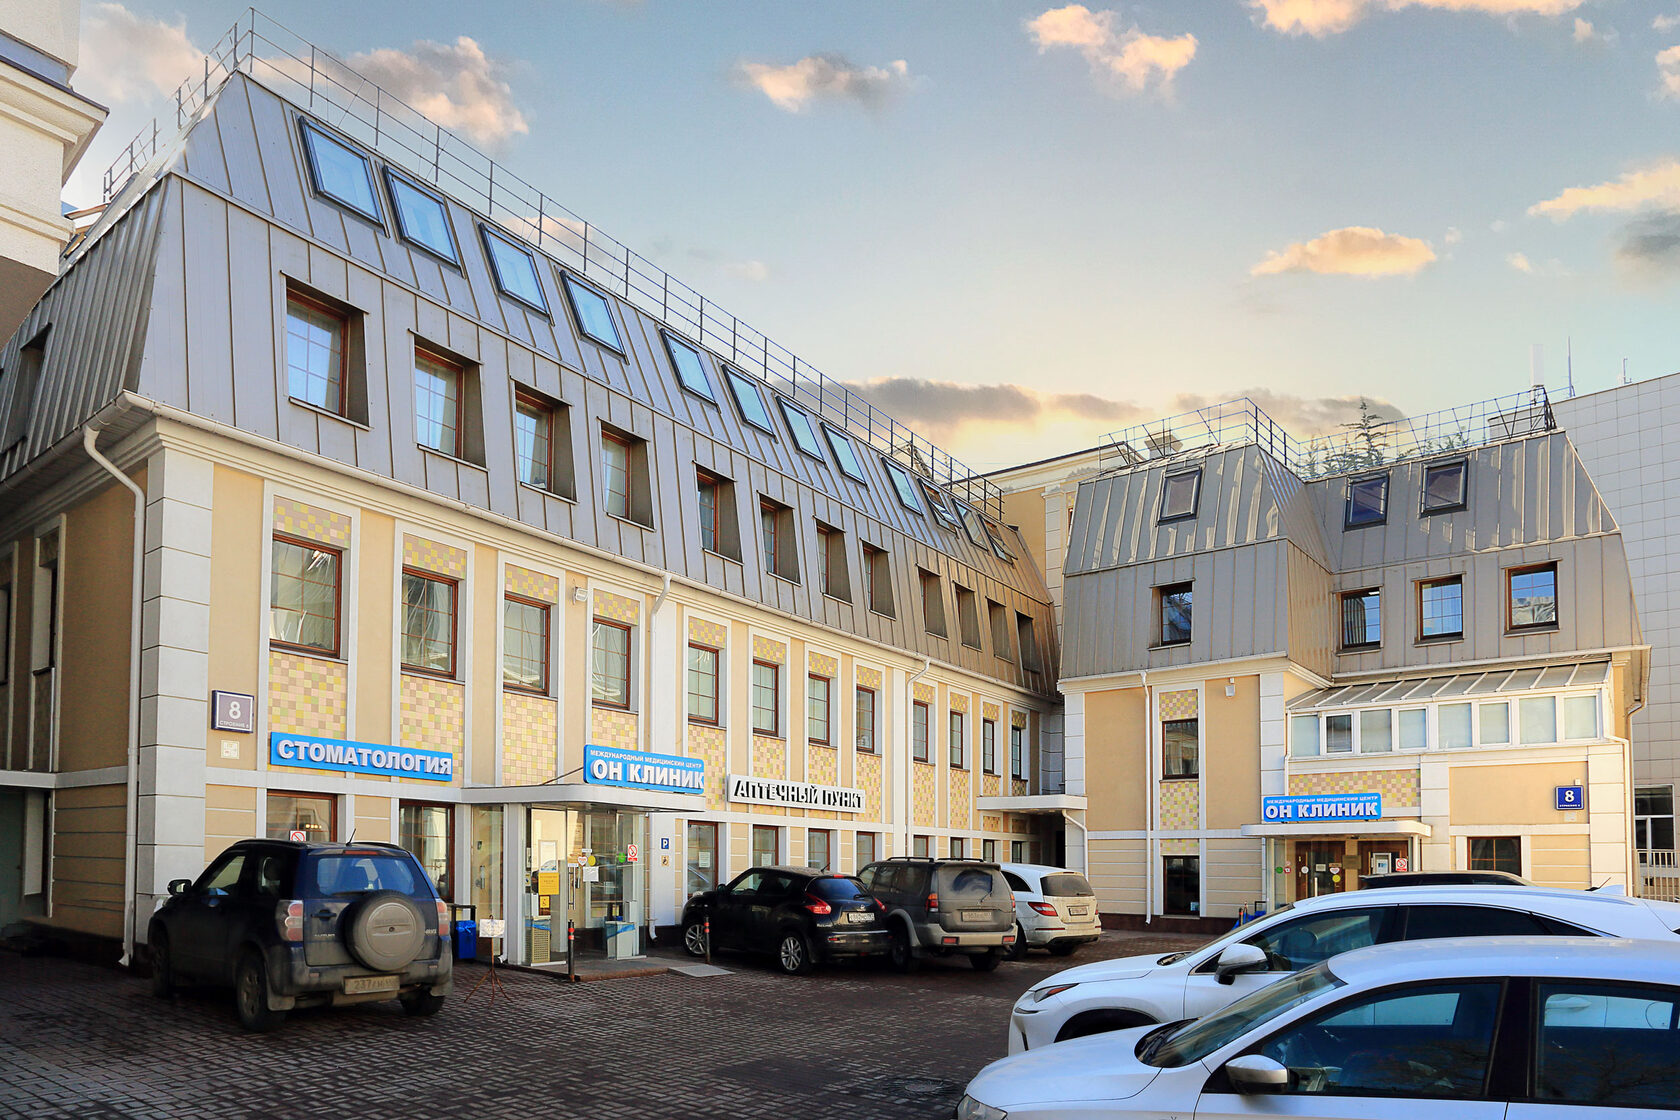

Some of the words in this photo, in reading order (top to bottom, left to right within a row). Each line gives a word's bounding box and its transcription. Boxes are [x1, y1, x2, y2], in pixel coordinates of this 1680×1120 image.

[228, 701, 241, 720] 8
[277, 739, 452, 775] СТОМАТОЛОГИЯ
[590, 749, 644, 762] МЕЖДУНАРОДНЫЙ
[645, 756, 684, 766] МЕДИЦИНСКИЙ
[591, 759, 622, 781] ОН
[627, 762, 704, 789] КЛИНИК
[734, 780, 818, 804] АПТЕЧНЫЙ
[822, 789, 862, 809] ПУНКТ
[1564, 790, 1575, 802] 8
[1266, 805, 1292, 819] ОН
[1297, 802, 1378, 818] КЛИНИК
